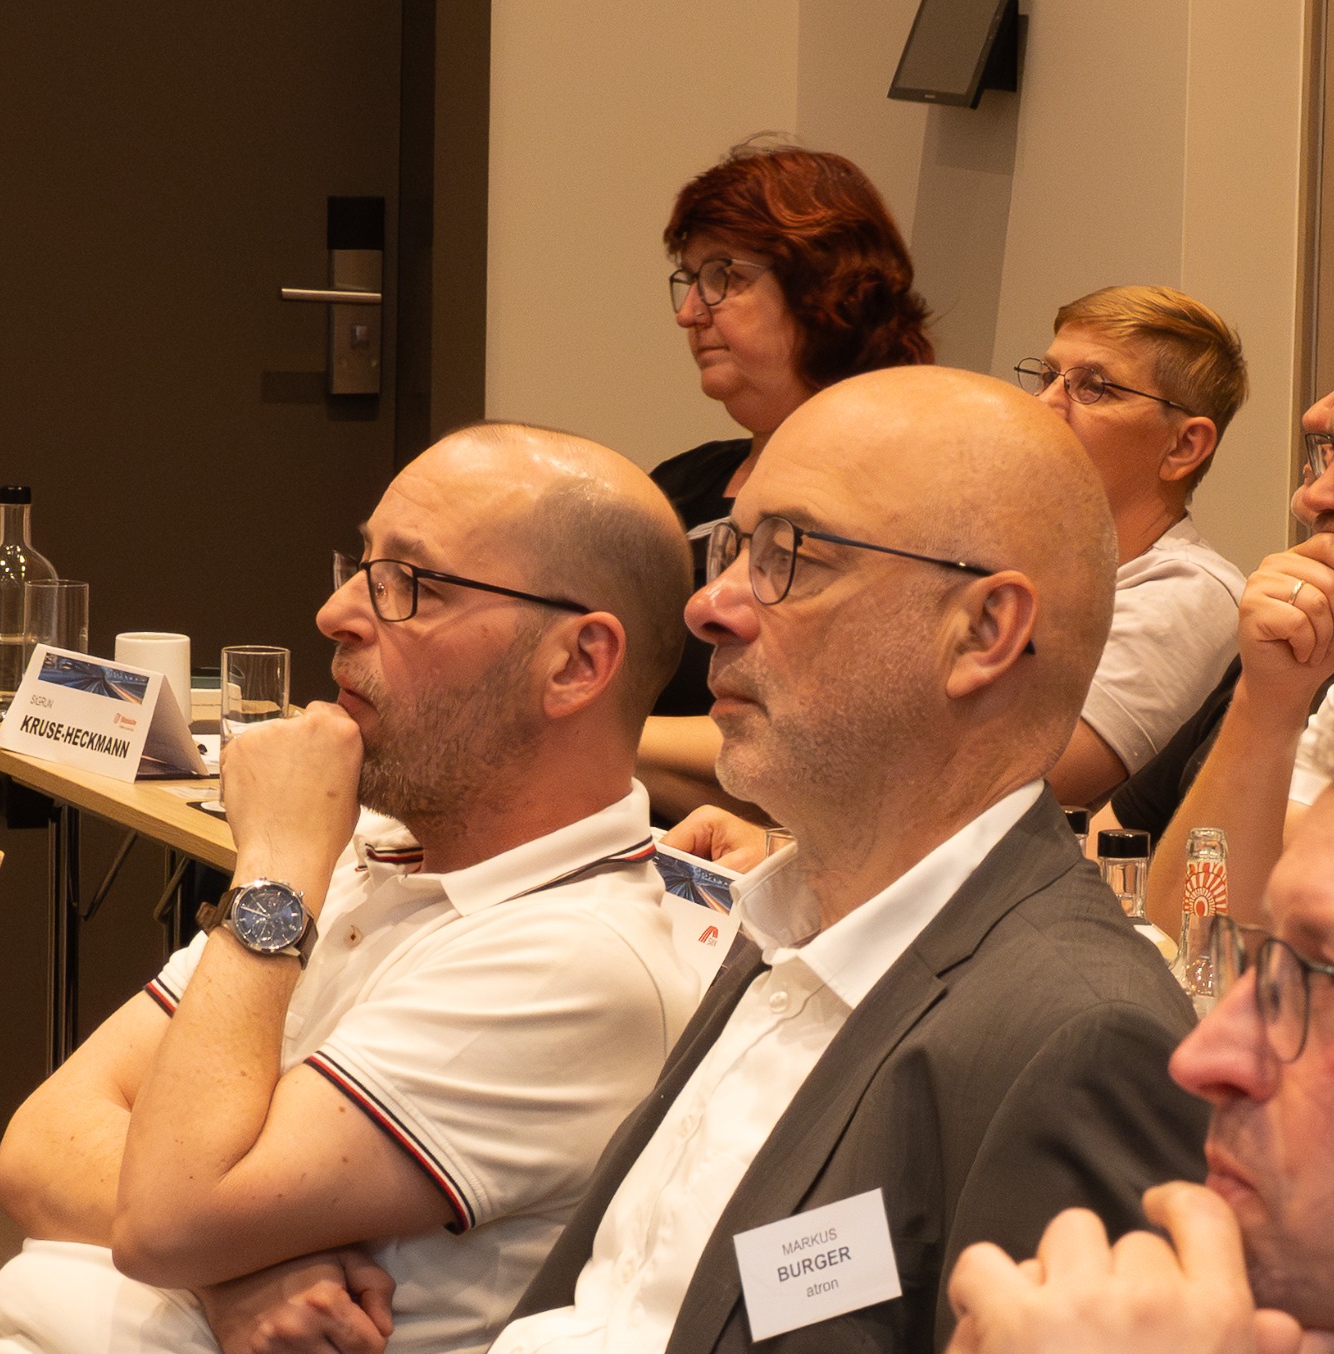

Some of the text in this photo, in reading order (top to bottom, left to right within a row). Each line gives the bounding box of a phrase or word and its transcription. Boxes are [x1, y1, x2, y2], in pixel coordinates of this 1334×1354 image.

[20, 714, 130, 759] KRUSE-HECKMANN
[782, 1227, 838, 1255] MARKUS
[777, 1246, 852, 1282] BURGER
[806, 1279, 839, 1298] atron
